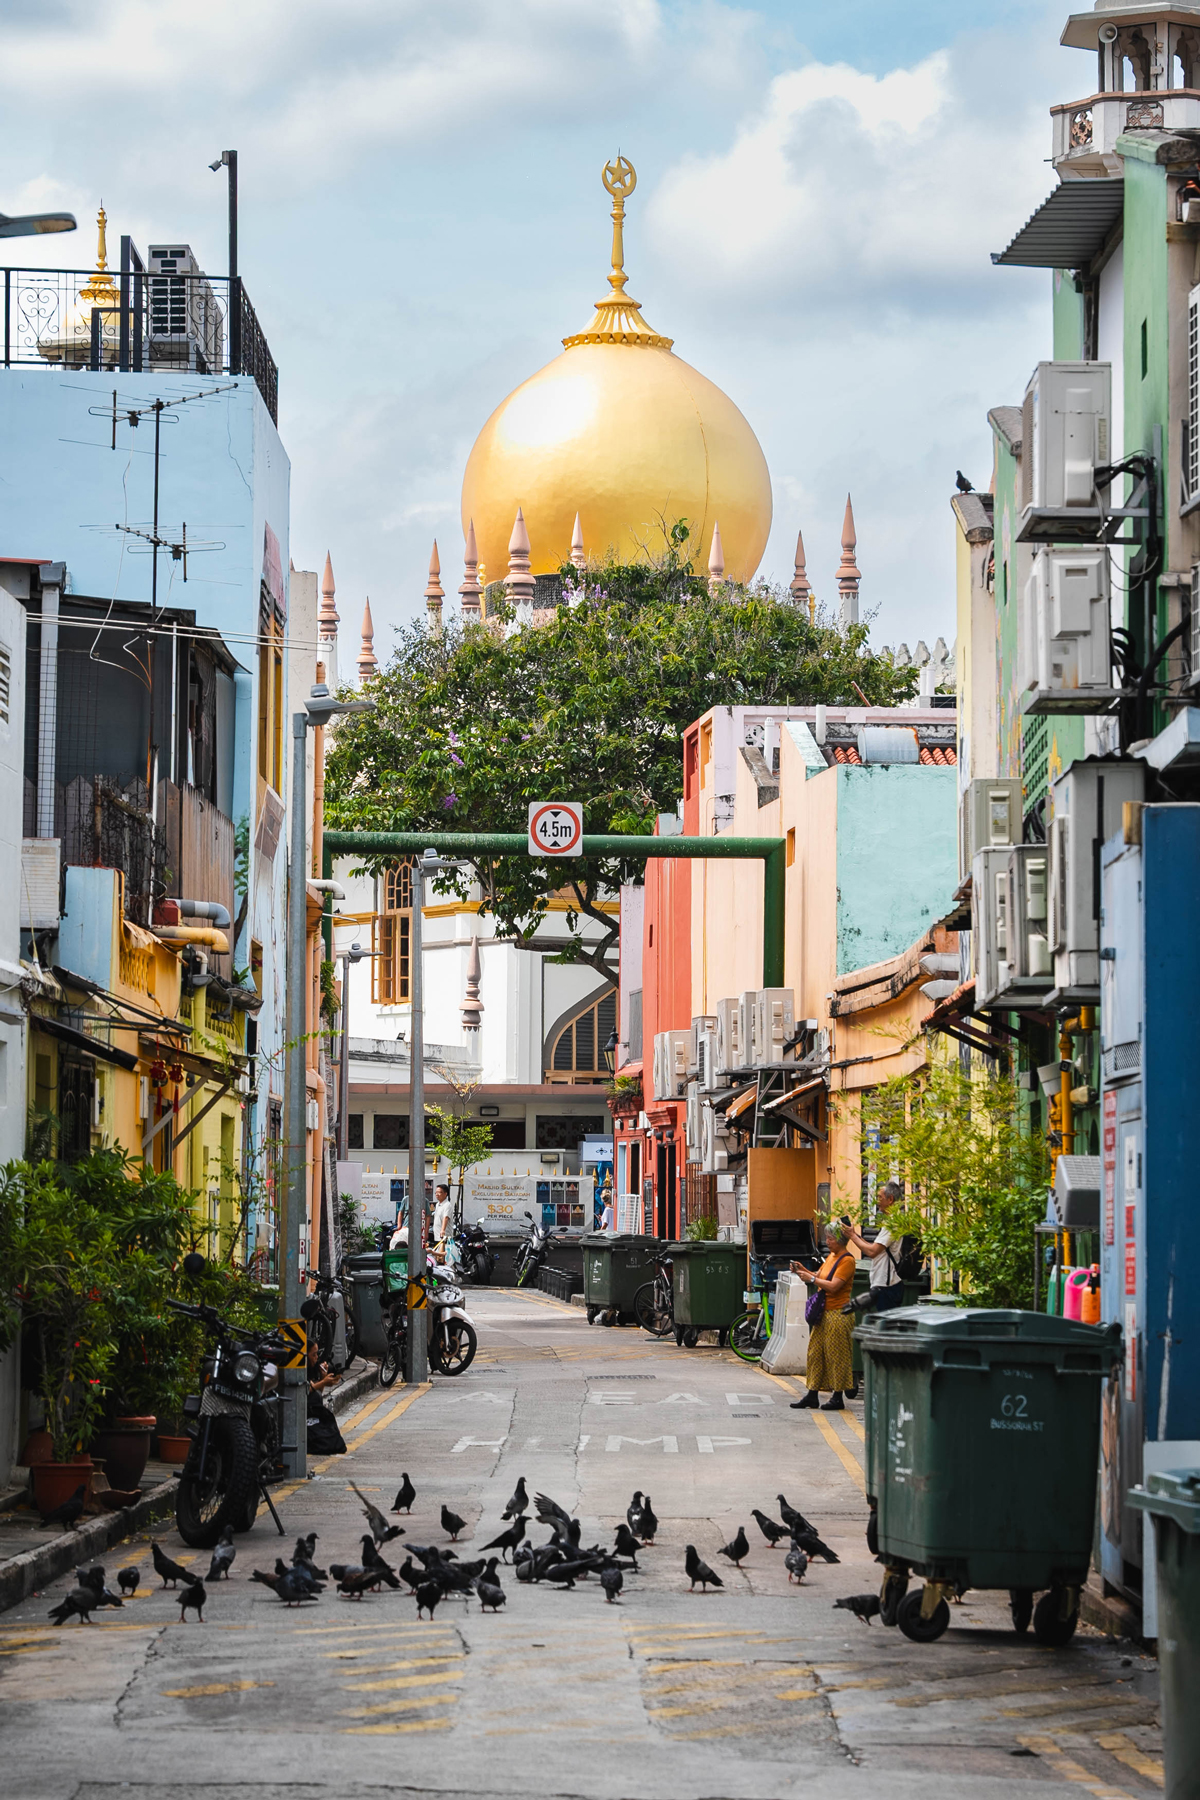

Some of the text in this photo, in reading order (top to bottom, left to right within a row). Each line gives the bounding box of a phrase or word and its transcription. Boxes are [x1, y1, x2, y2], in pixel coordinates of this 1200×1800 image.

[540, 820, 572, 838] 4.5m
[487, 1203, 514, 1215] $30
[264, 1300, 274, 1312] 76
[1000, 1394, 1029, 1418] 62
